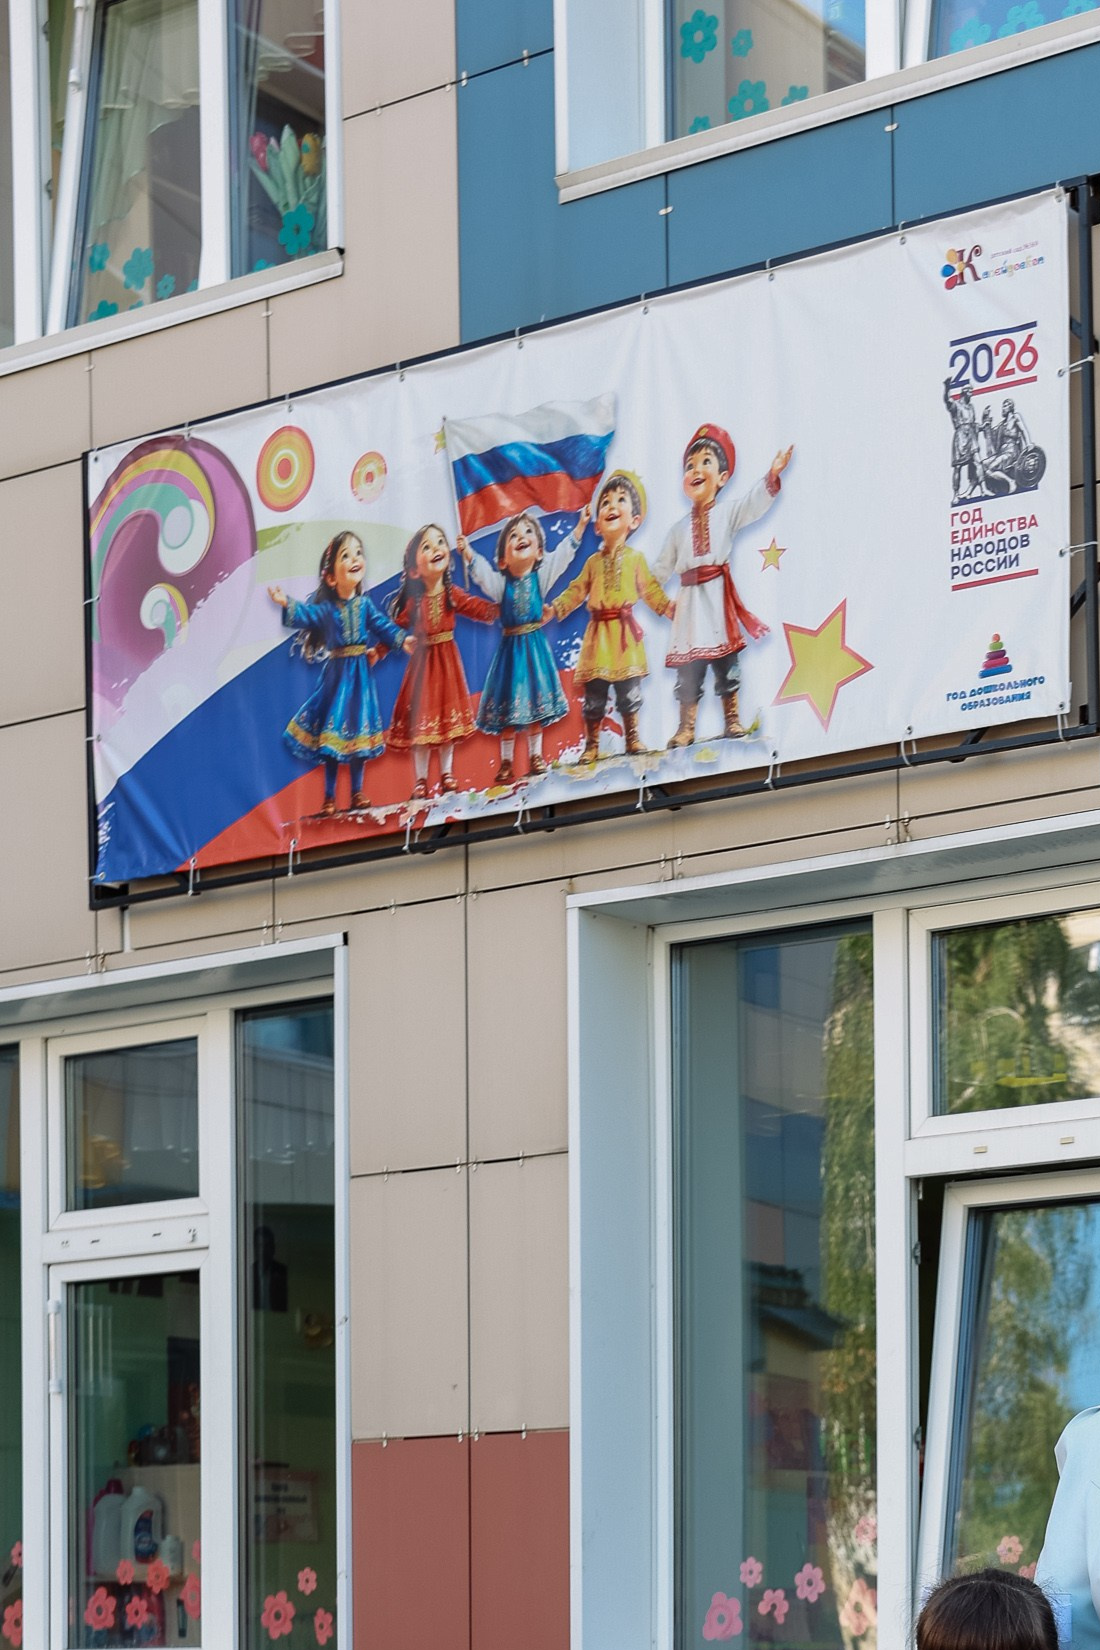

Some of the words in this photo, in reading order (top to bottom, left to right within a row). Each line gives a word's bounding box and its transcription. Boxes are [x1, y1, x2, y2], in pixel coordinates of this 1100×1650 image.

[949, 333, 1039, 389] 2026
[951, 507, 983, 527] ГОД
[951, 514, 1039, 545] ЕДИНСТВА
[951, 533, 1030, 562] НАРОДОВ
[951, 553, 1020, 580] РОССИИ
[946, 690, 967, 701] ГОД
[968, 675, 1046, 698] ДОШКОЛЬНОГО
[960, 690, 1032, 711] ОБРАЗОВАНИЯ
